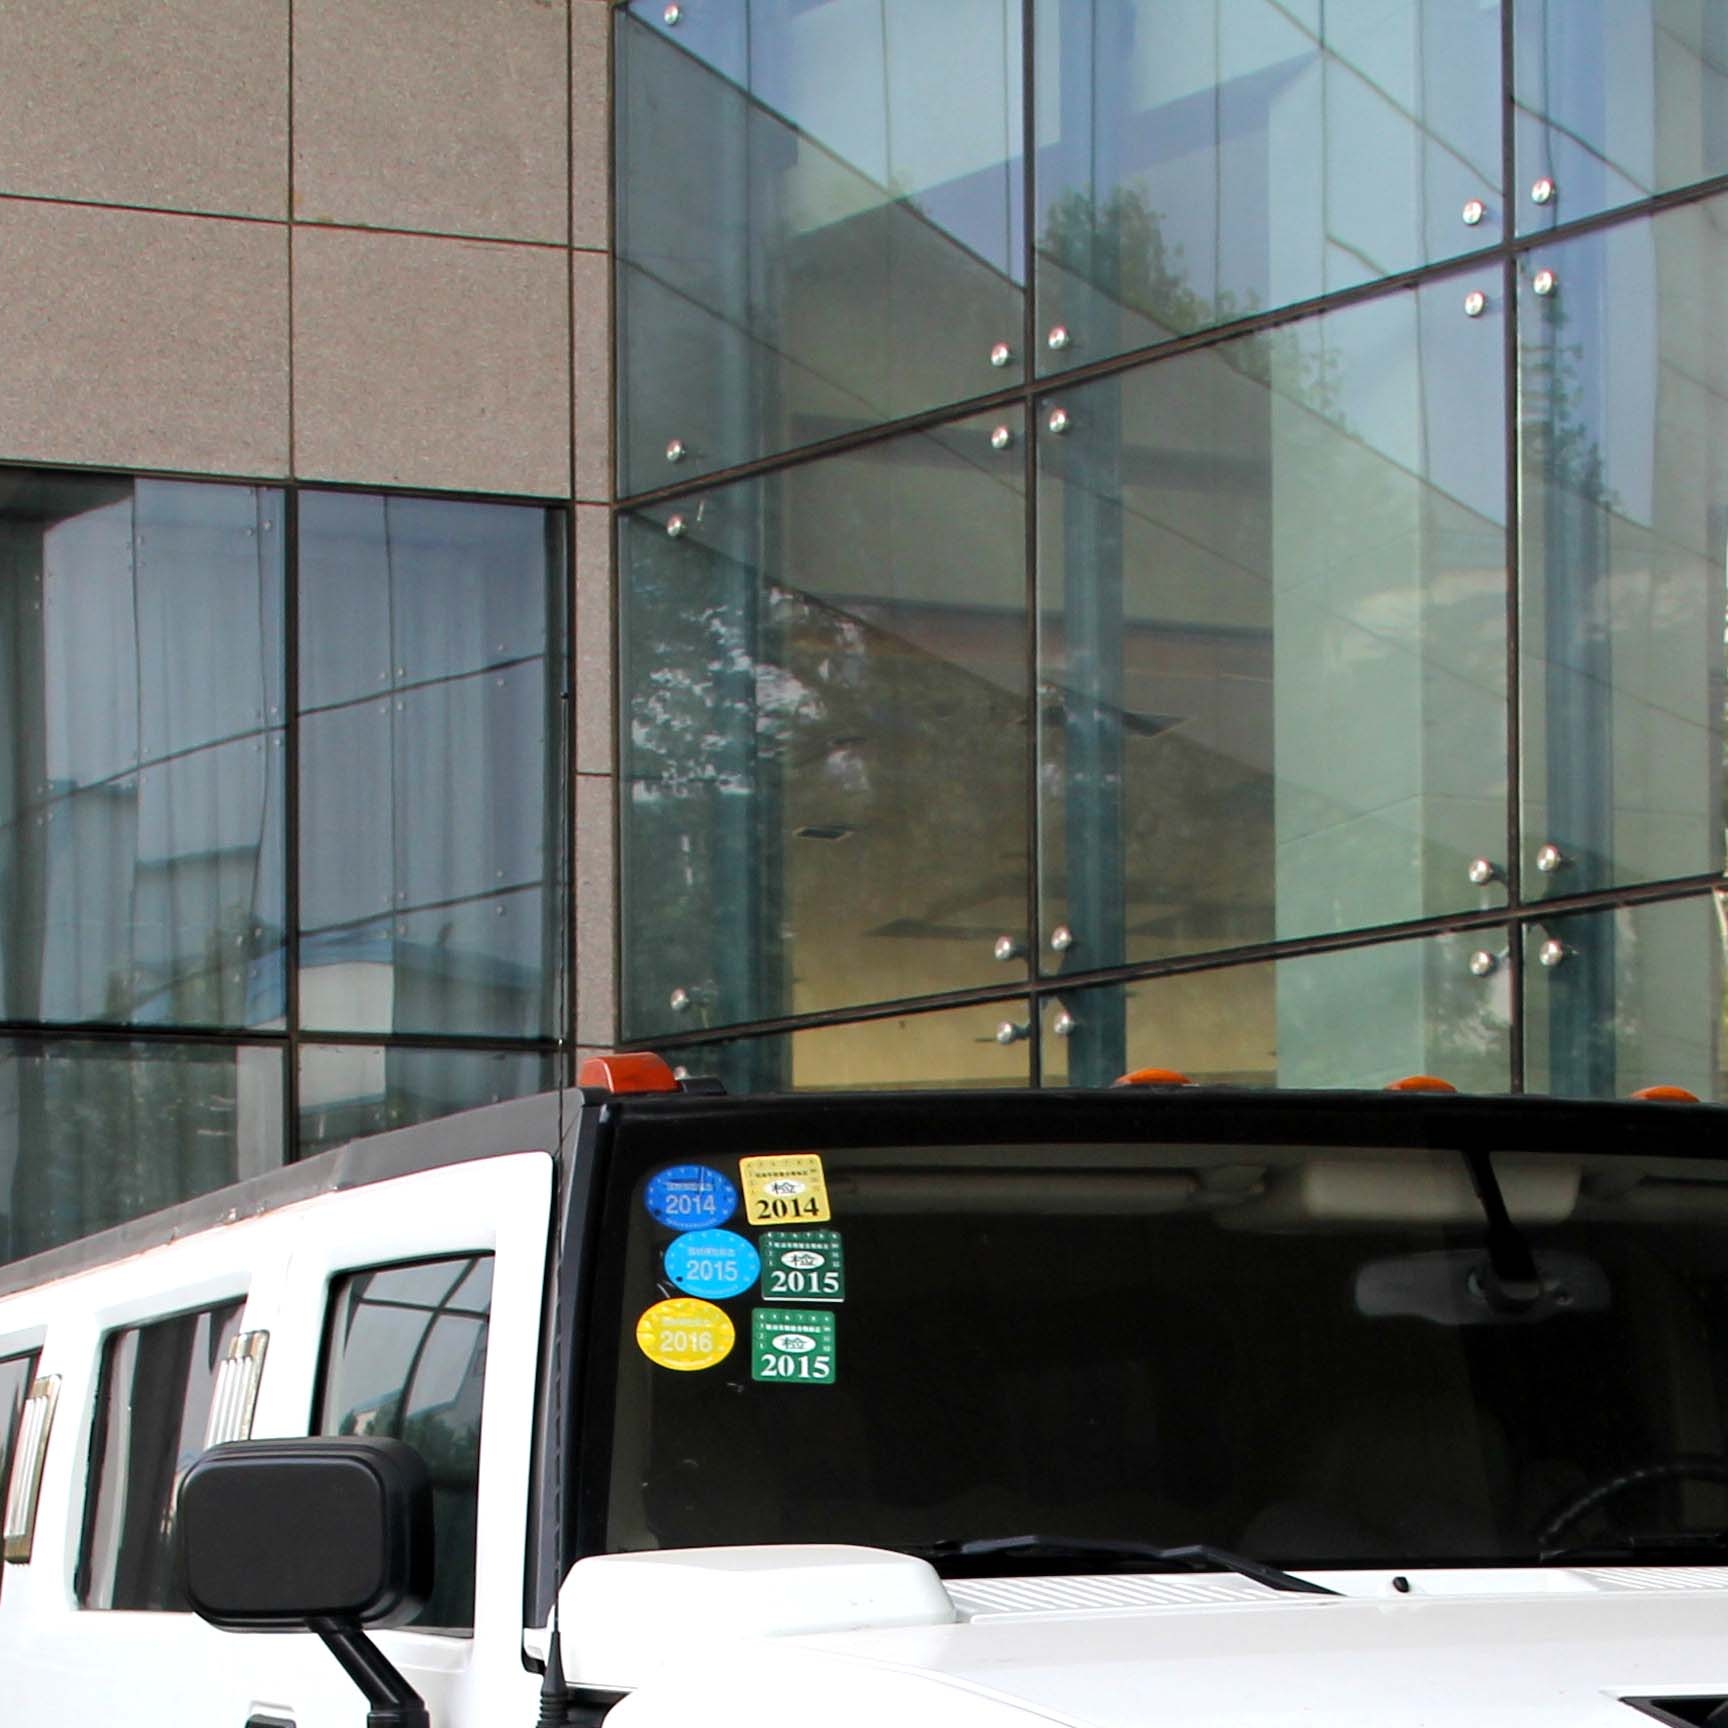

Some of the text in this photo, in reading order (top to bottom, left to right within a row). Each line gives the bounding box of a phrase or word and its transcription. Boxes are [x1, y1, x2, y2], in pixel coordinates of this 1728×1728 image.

[665, 1193, 717, 1215] 2014
[757, 1197, 819, 1220] 2014
[686, 1259, 738, 1282] 2015
[770, 1270, 840, 1294] 2015
[659, 1330, 713, 1353] 2016
[759, 1353, 830, 1379] 2015
